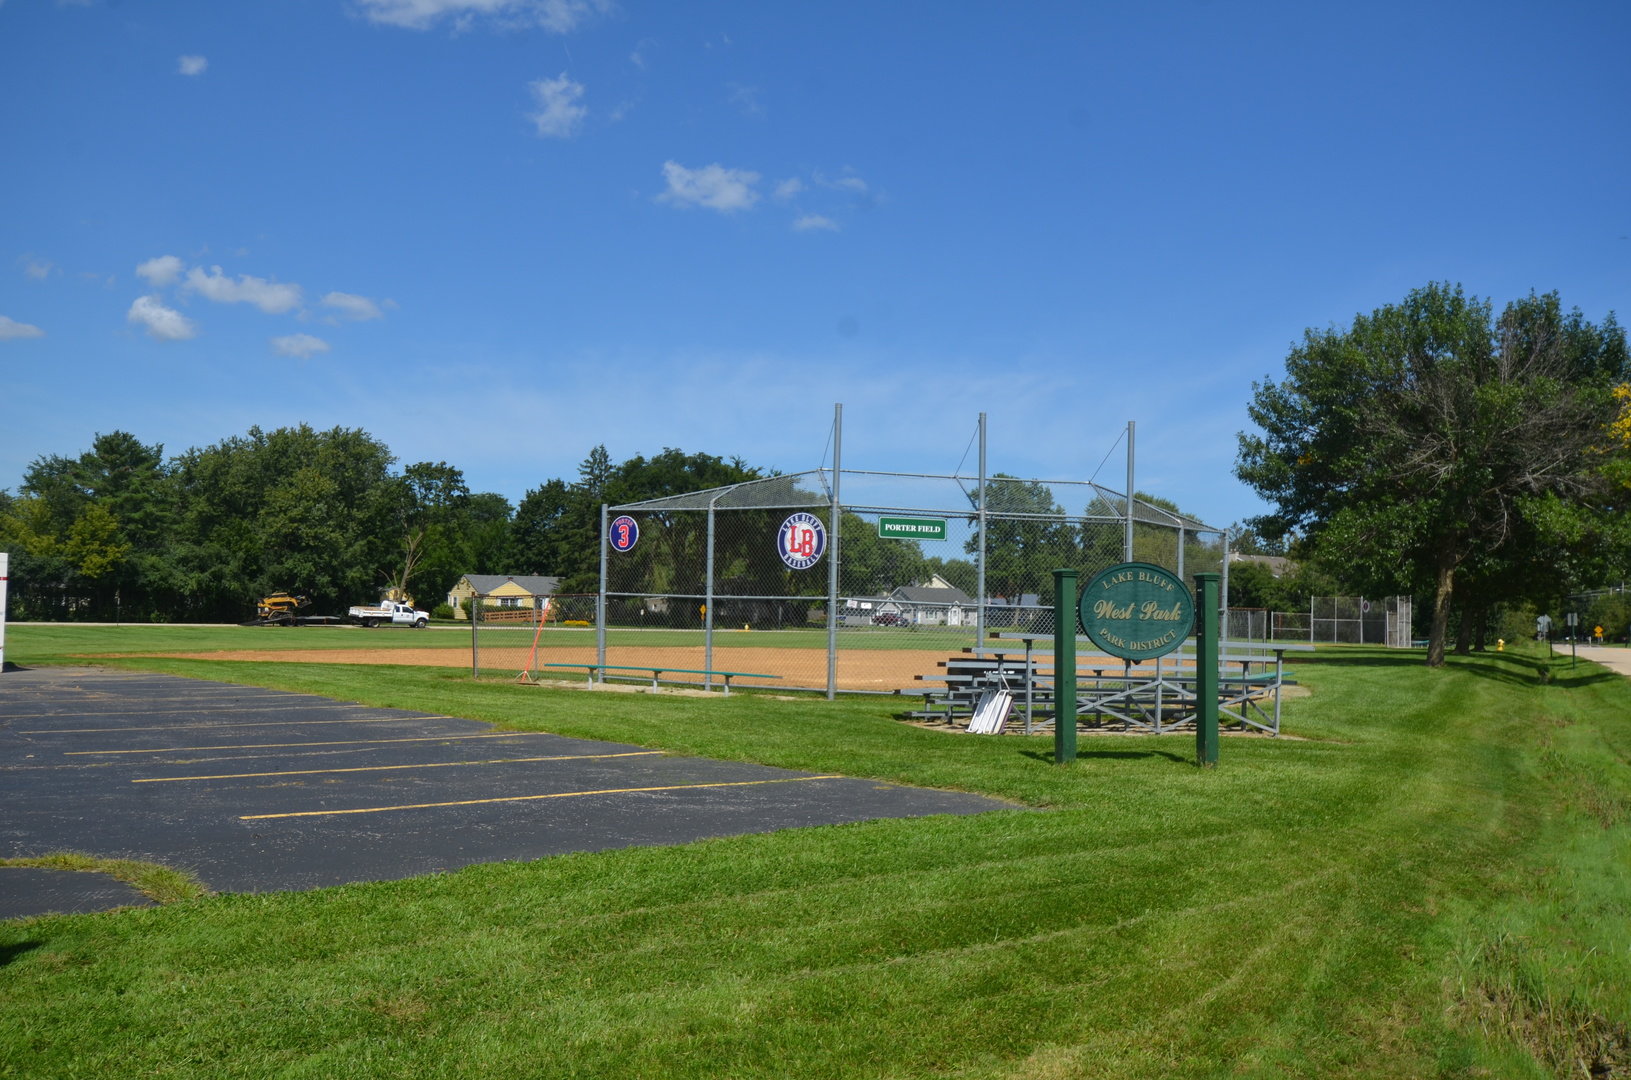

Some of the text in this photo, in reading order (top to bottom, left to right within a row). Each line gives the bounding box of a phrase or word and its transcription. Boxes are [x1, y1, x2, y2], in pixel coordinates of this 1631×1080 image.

[782, 514, 821, 532] LAKE BLUFF
[885, 523, 941, 533] PORTER FIELD
[618, 525, 629, 547] 3
[789, 525, 814, 557] LB
[783, 553, 819, 568] BASEBALL
[1102, 571, 1175, 593] LAKE BLUFF
[1093, 599, 1182, 621] West Park
[1100, 627, 1177, 651] PARK DISTRICT
